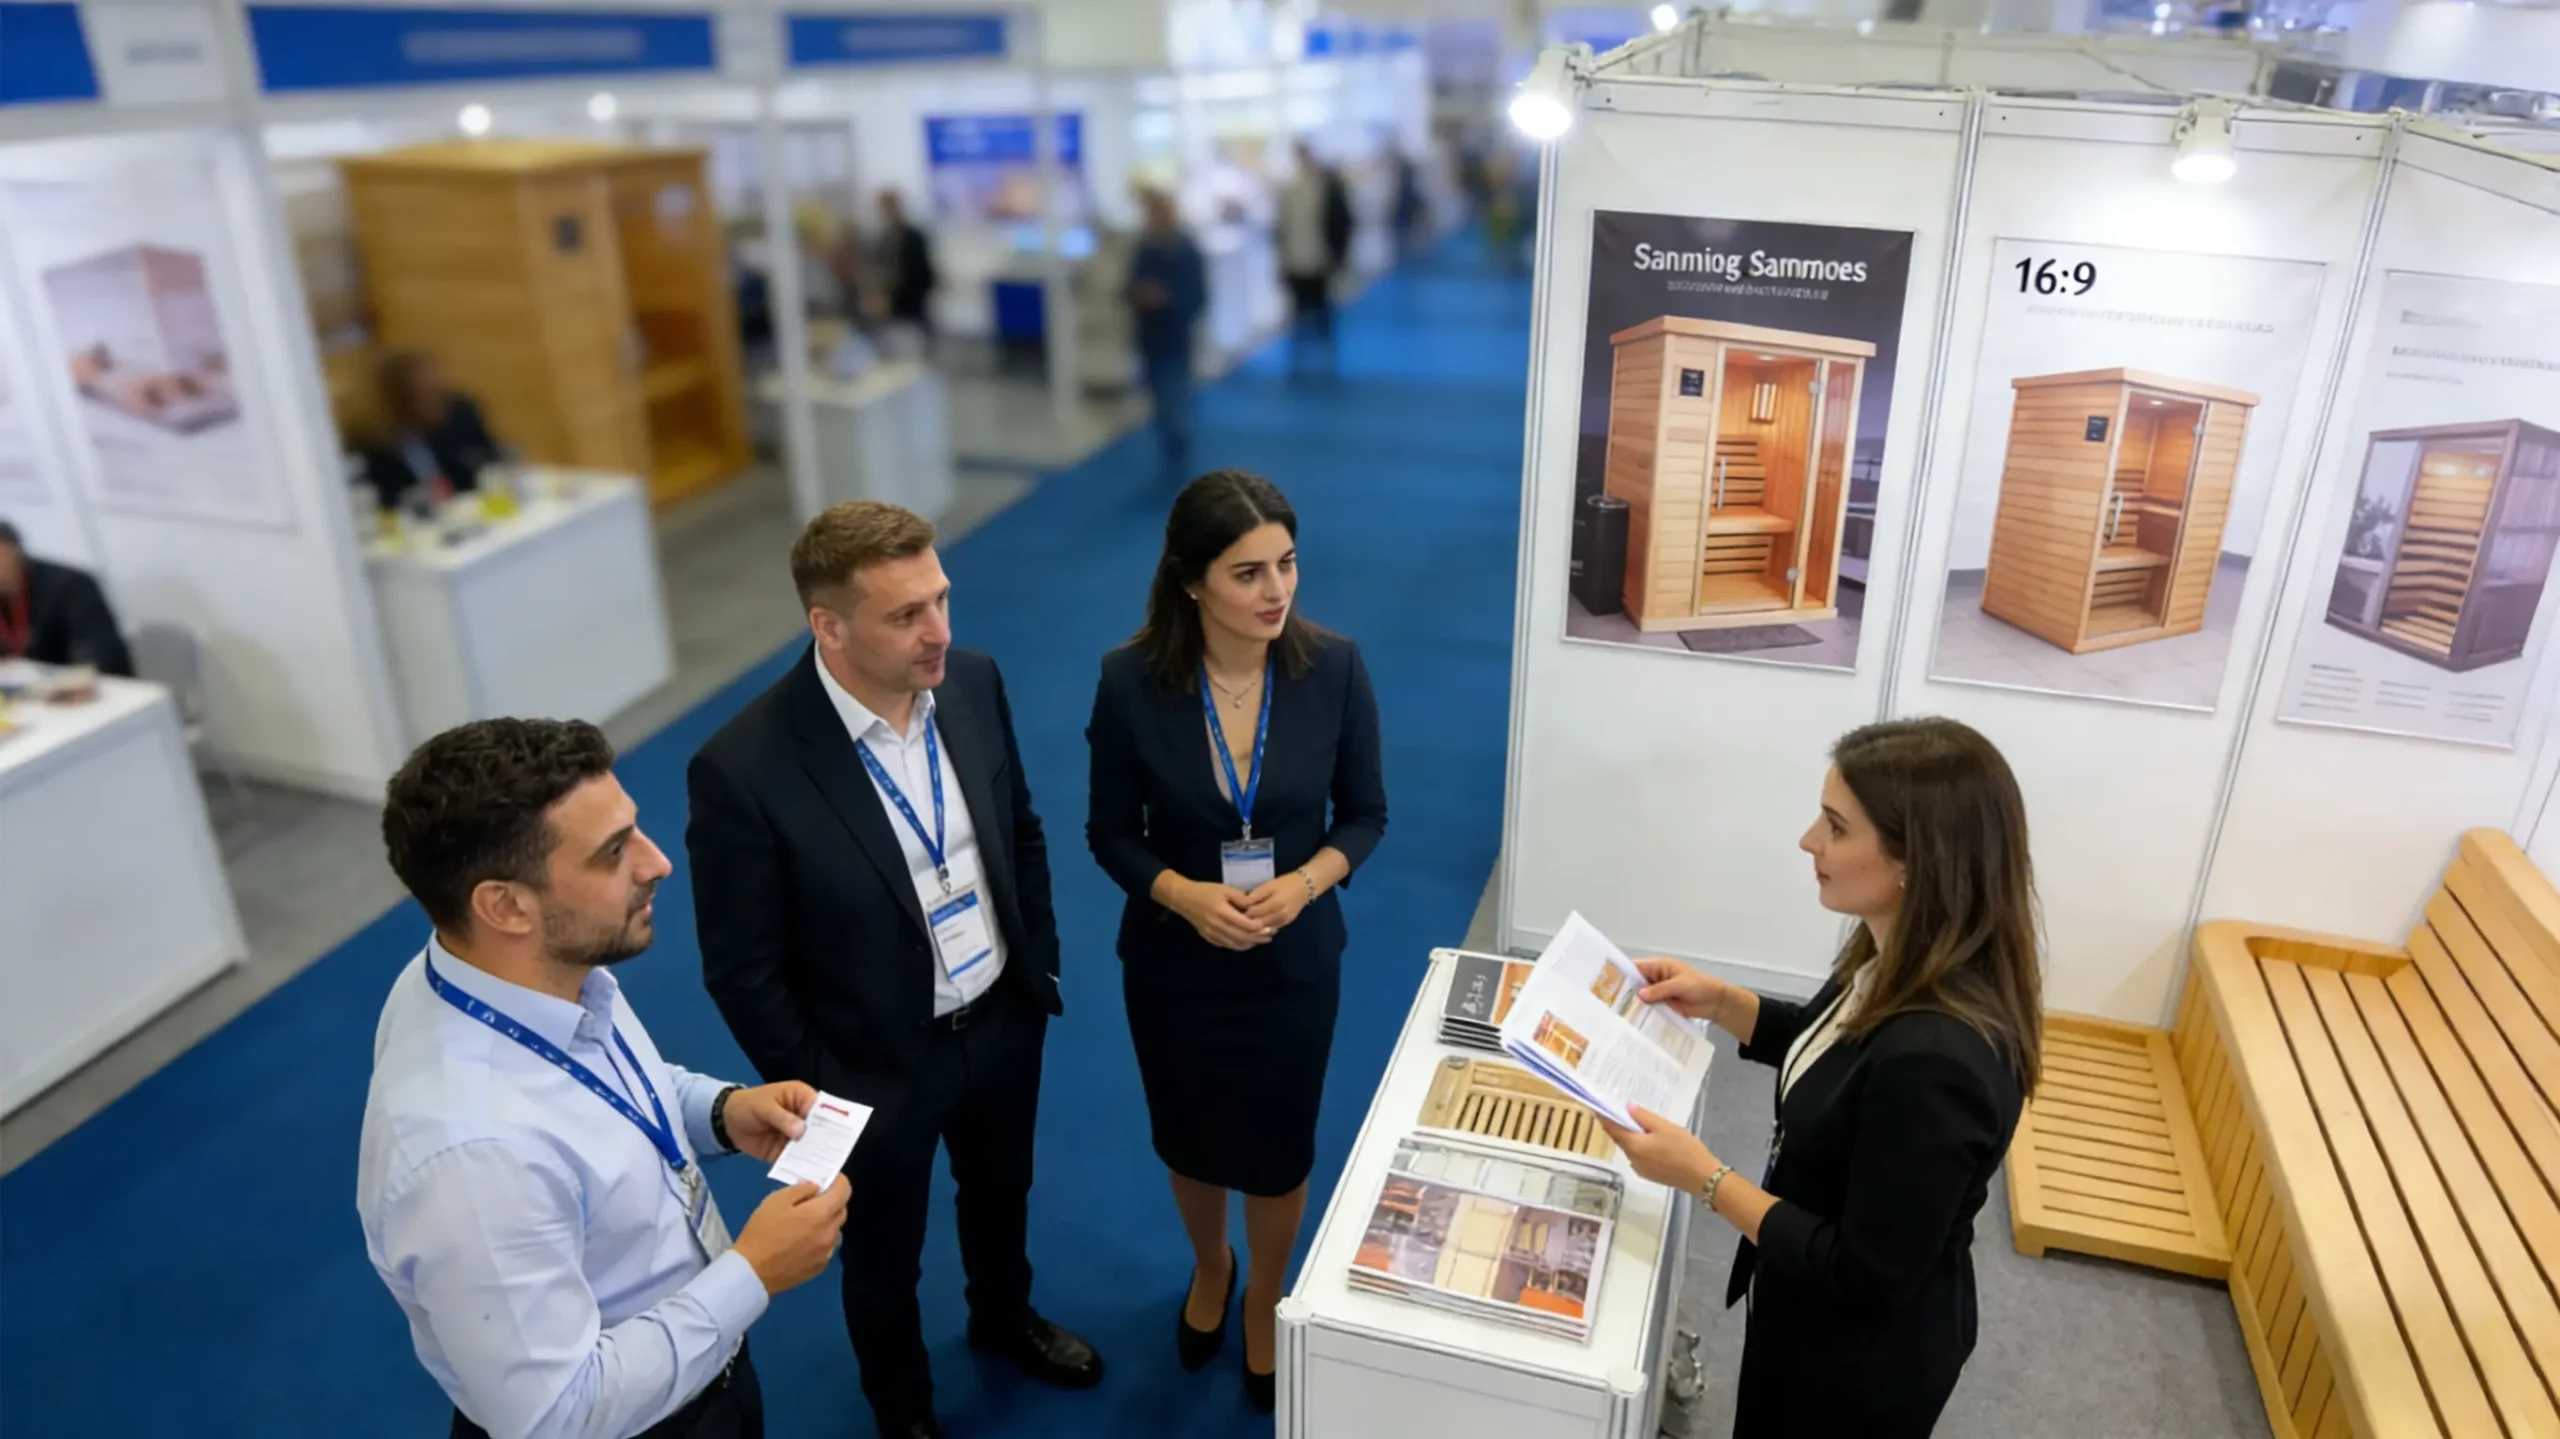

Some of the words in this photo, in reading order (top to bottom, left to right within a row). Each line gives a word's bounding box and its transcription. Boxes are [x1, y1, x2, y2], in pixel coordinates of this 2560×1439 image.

[1633, 242, 1743, 282] Sanmiog
[1748, 249, 1868, 282] Sammoes
[2015, 257, 2098, 296] 16:9
